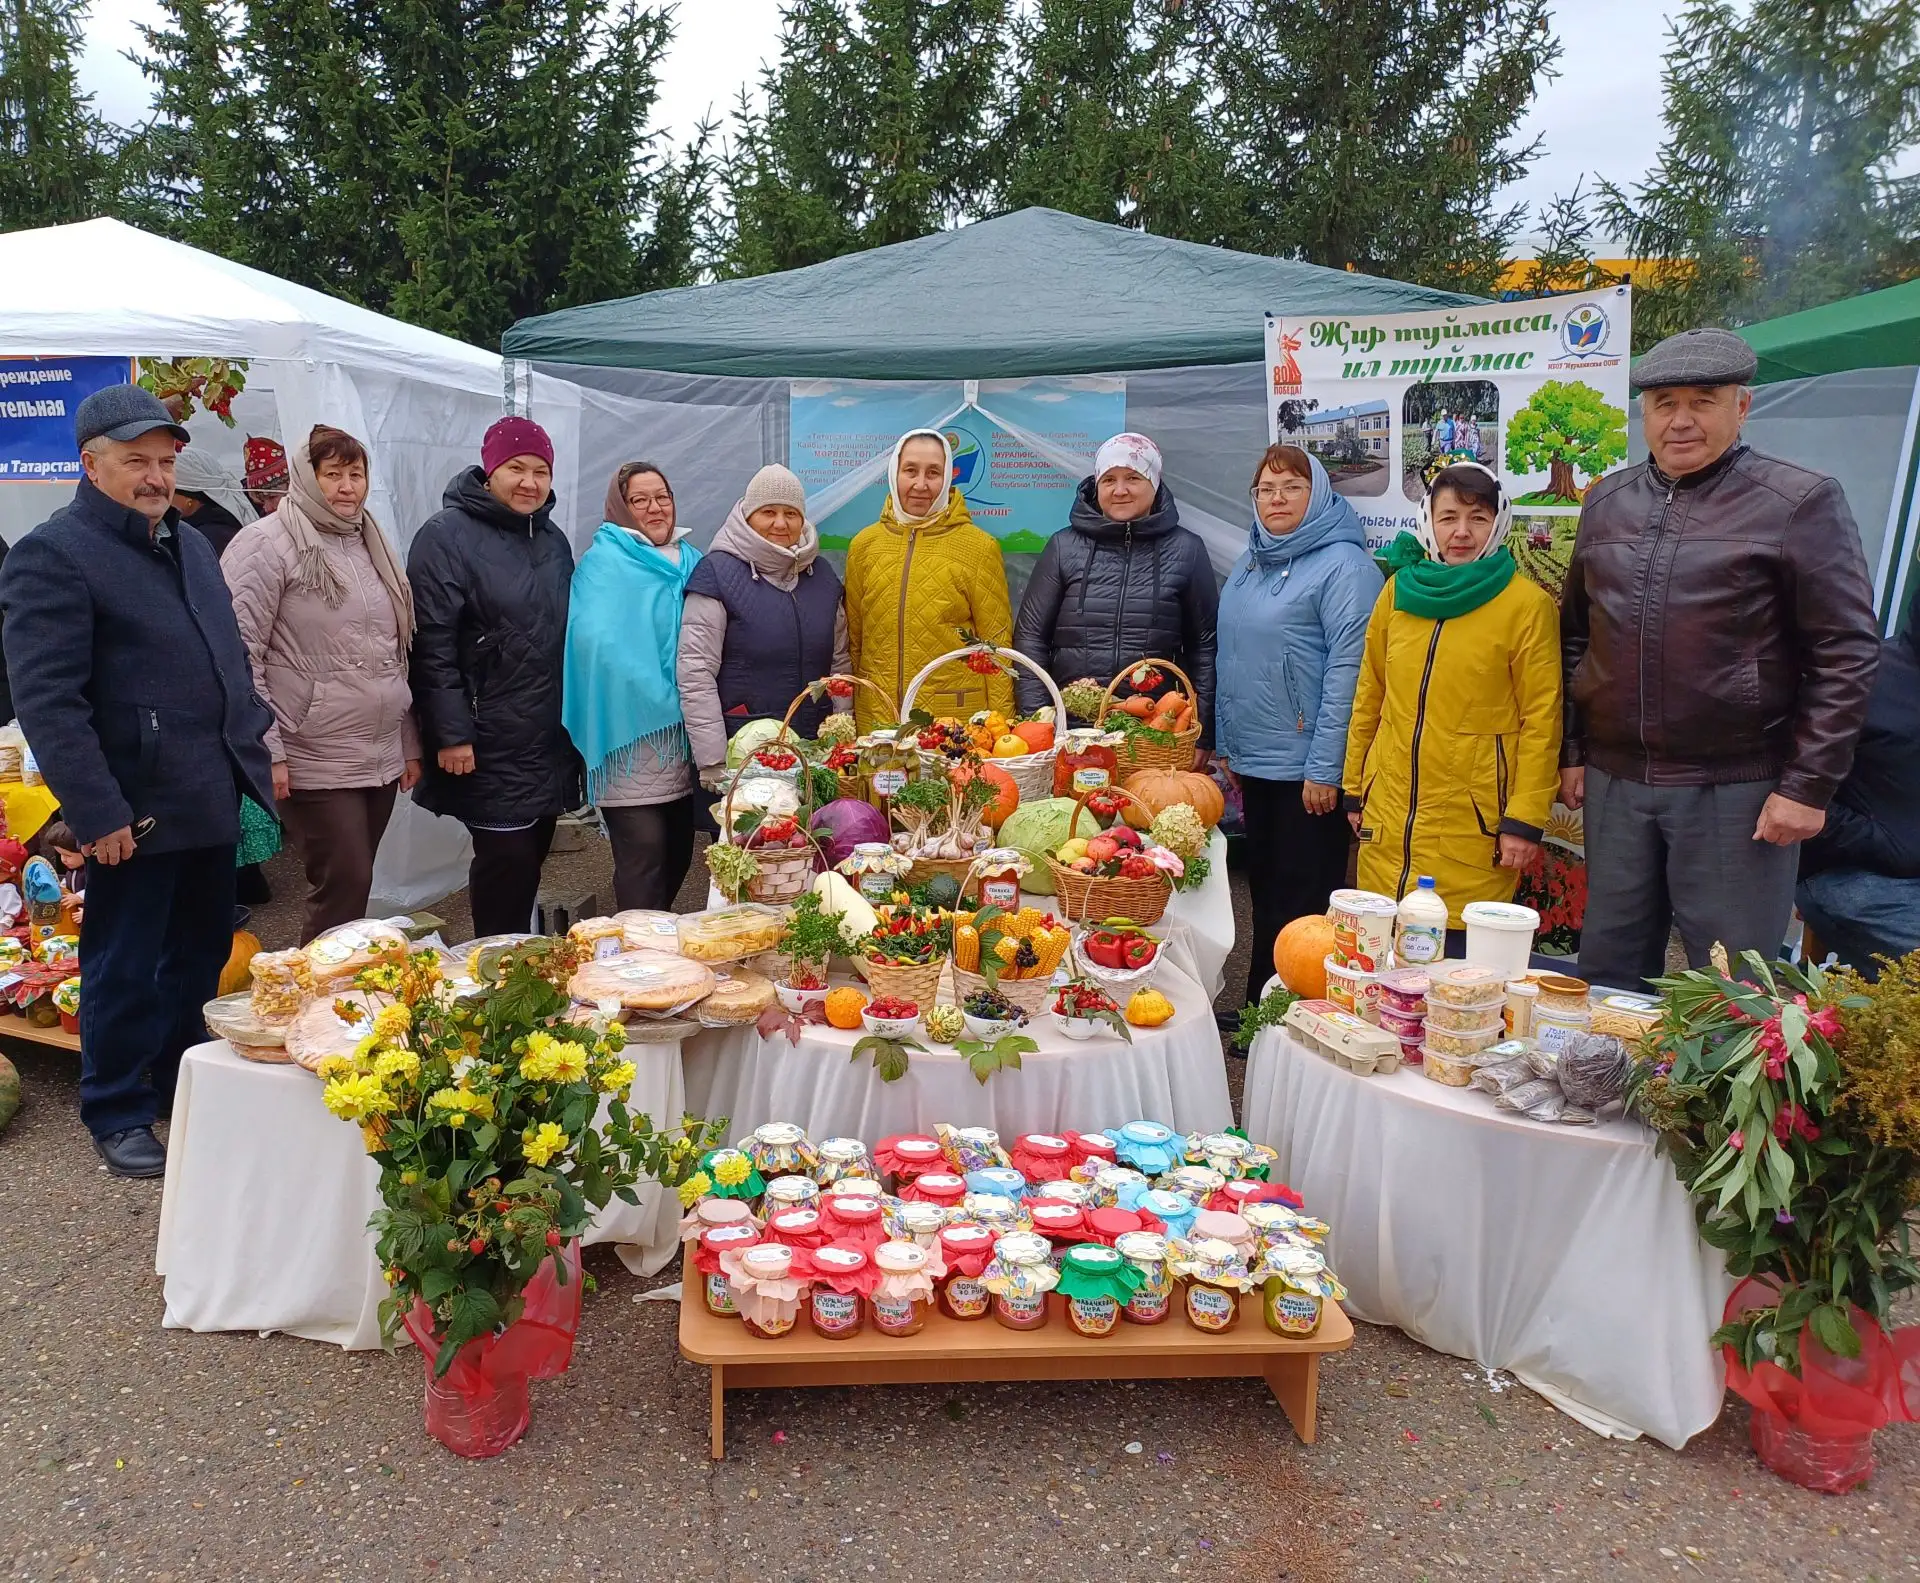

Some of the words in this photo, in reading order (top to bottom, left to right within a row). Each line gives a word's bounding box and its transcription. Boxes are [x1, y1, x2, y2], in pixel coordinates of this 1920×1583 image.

[1394, 313, 1559, 350] туймаса,
[1341, 360, 1382, 379] ил
[1387, 345, 1534, 384] туймас
[11, 459, 80, 476] Татарстан
